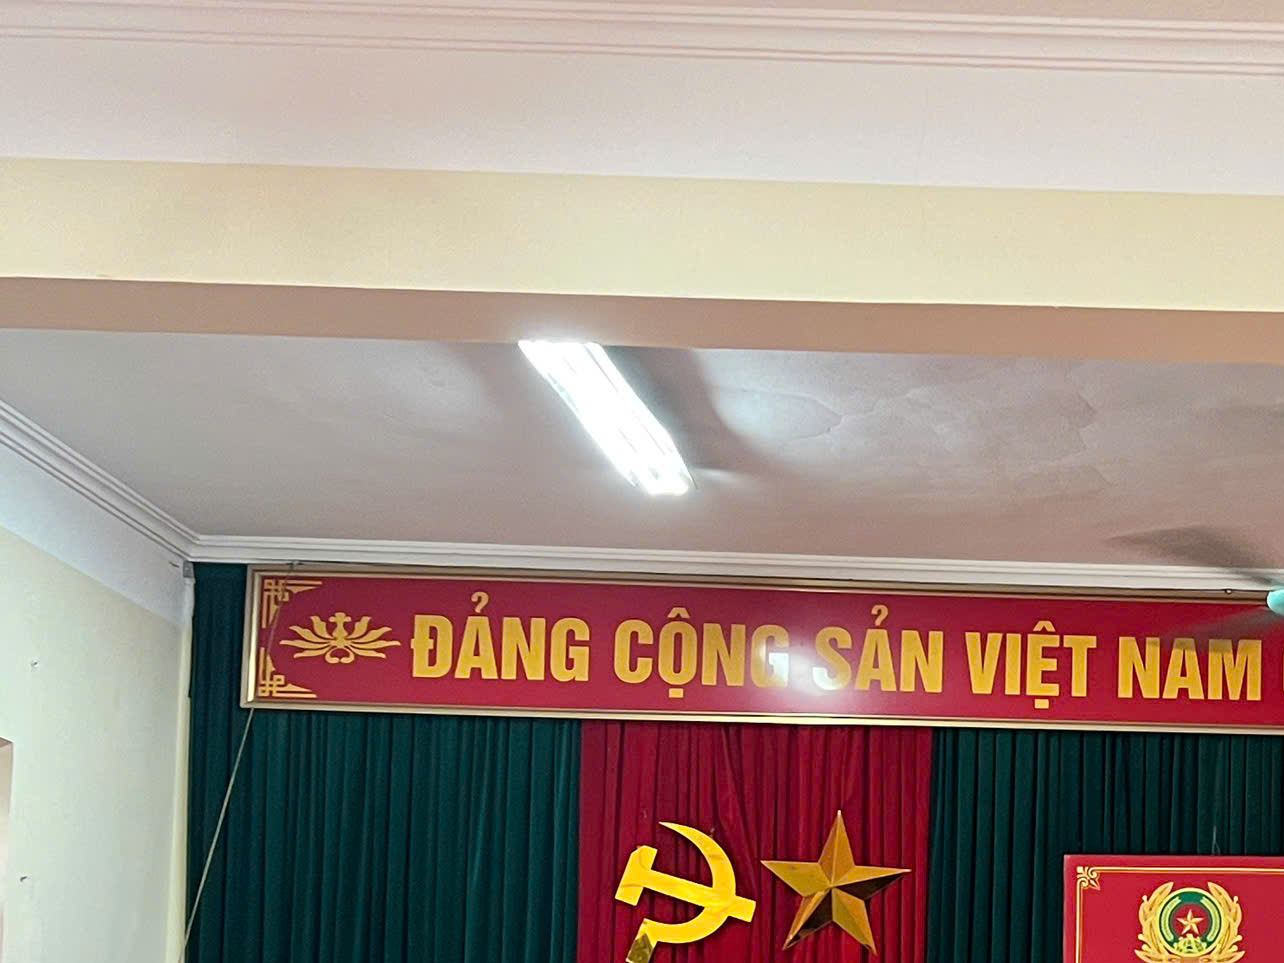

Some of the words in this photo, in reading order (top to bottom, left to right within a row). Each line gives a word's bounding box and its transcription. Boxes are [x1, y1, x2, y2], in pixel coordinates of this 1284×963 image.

[411, 591, 590, 682] ĐẢNG
[614, 607, 790, 698] CỘNG
[813, 604, 944, 693] SẢN
[965, 621, 1097, 709] VIỆT
[1117, 636, 1262, 701] NAM
